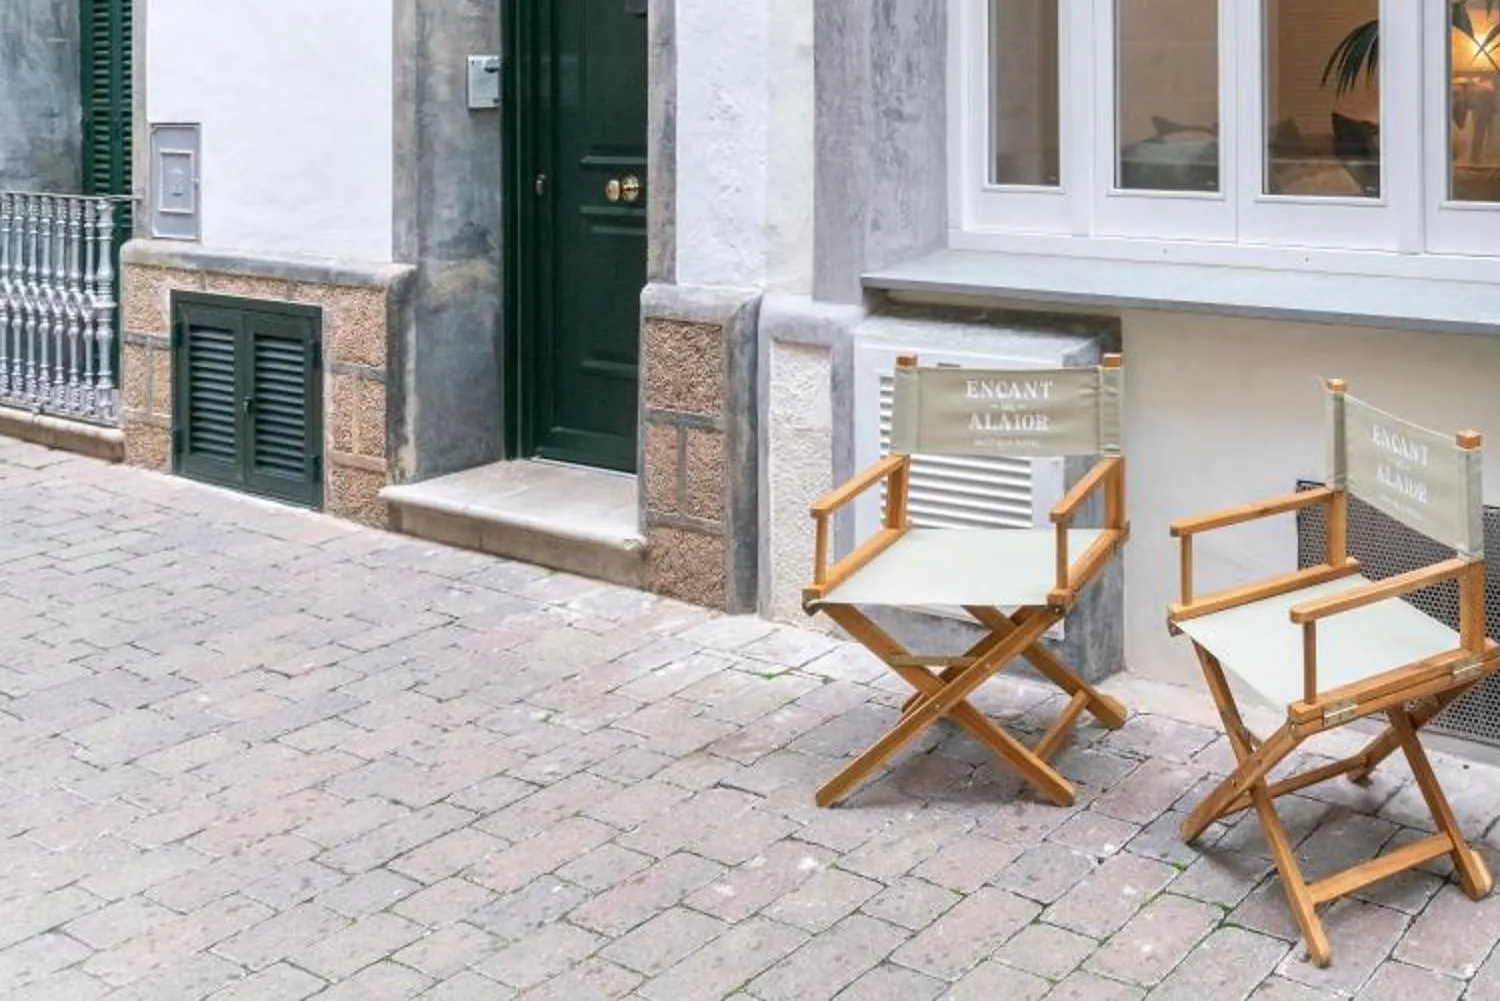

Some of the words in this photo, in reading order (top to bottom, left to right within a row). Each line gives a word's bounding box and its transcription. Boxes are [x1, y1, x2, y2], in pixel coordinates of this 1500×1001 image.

[966, 378, 1053, 399] ENCANT
[968, 411, 1049, 431] ALAIOR
[1372, 422, 1428, 467] ENCANT
